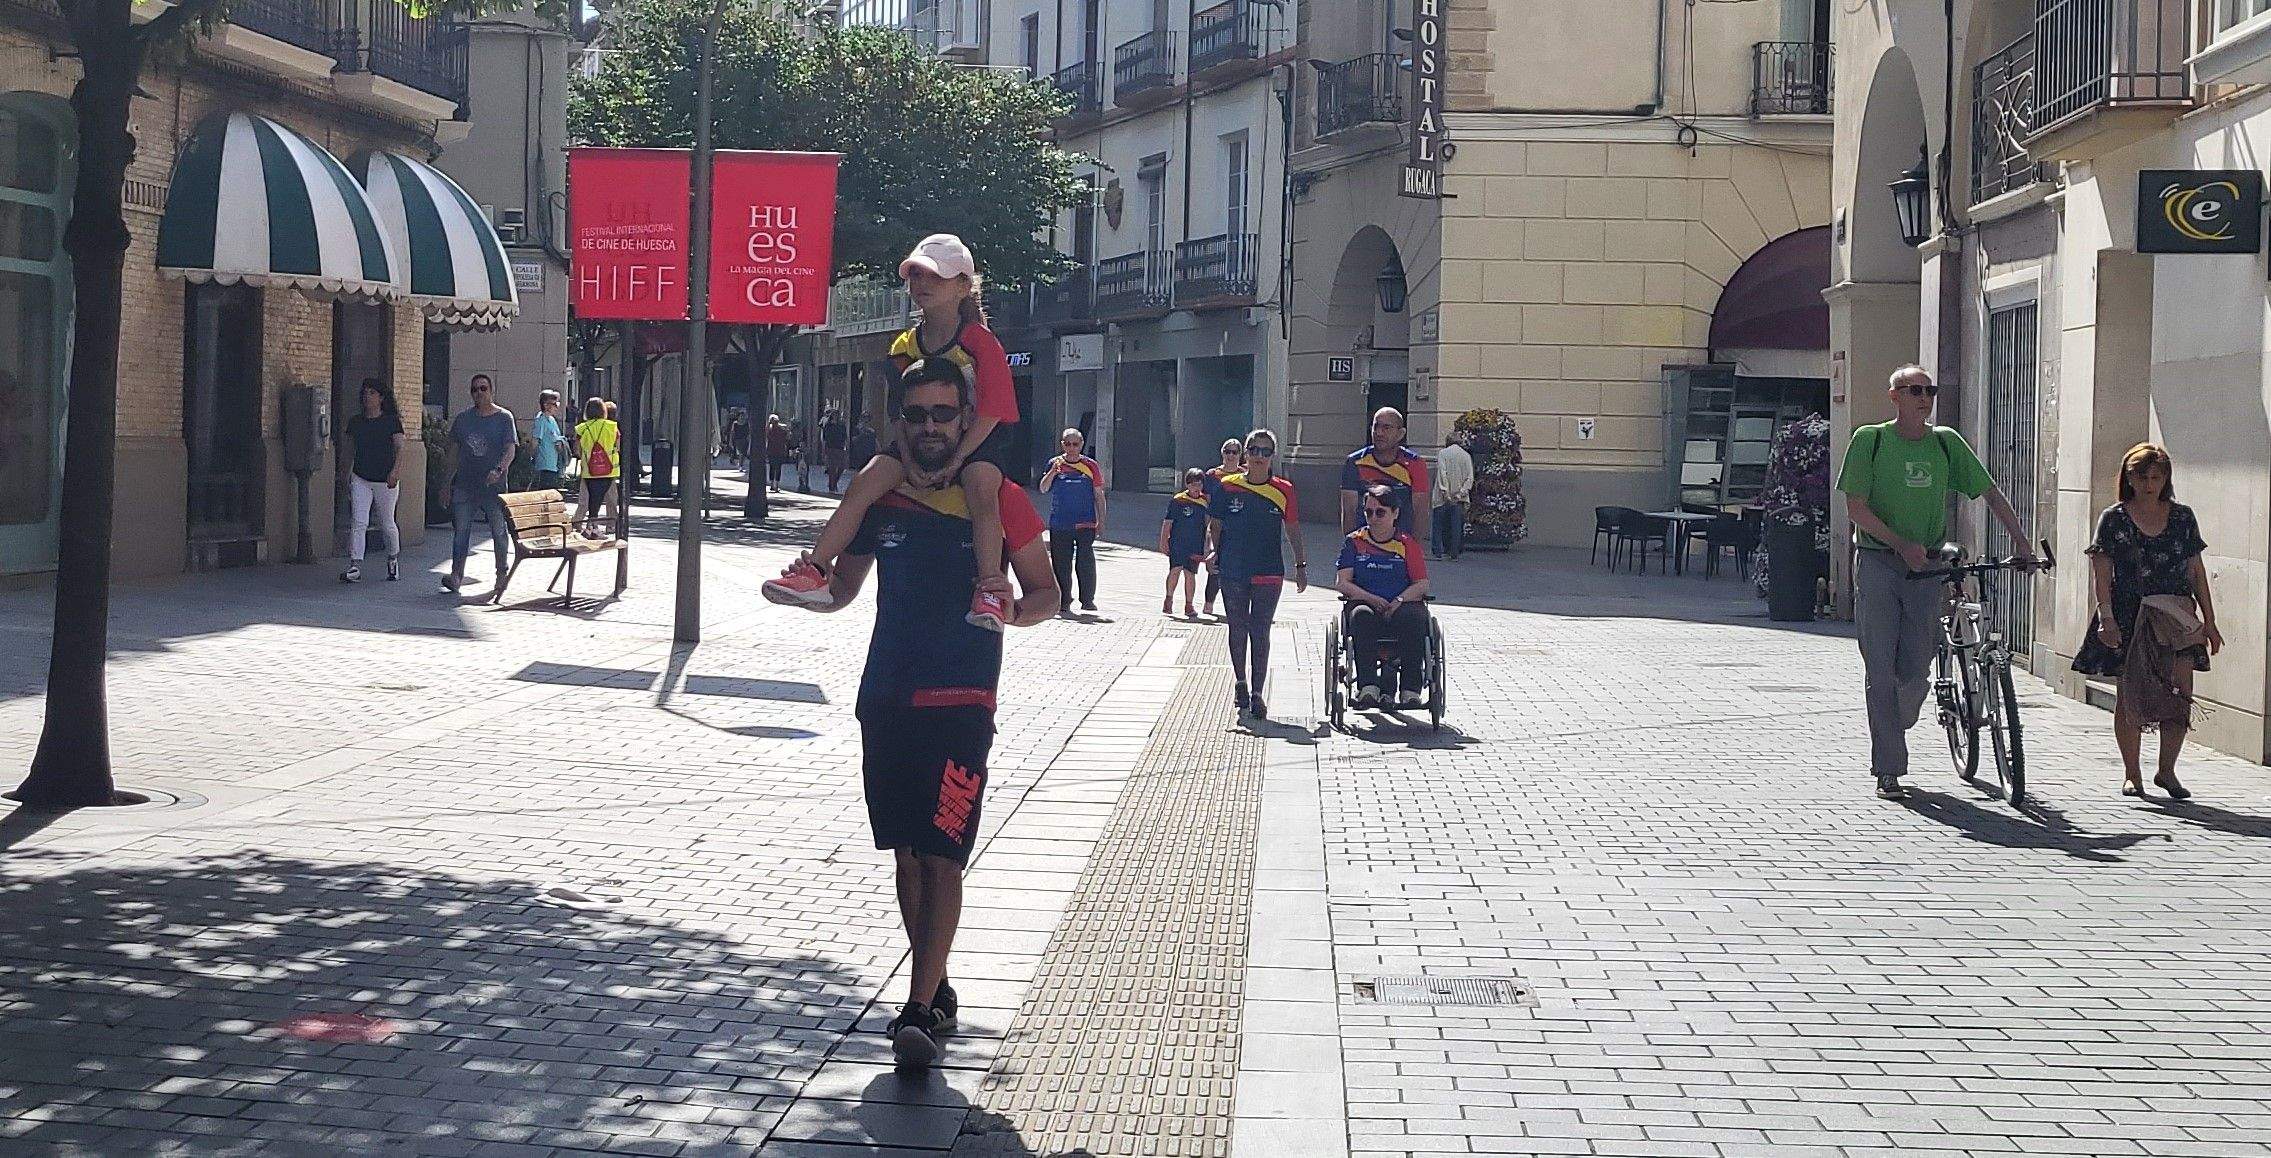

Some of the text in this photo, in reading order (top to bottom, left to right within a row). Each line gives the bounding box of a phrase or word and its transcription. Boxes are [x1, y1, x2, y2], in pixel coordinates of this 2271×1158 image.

[1418, 0, 1439, 161] HOSTAL
[1405, 166, 1436, 196] RUGACA
[581, 222, 675, 237] FESTIVAL INTERNACIONAL
[581, 238, 676, 251] DE CINE DE HUESCA
[580, 265, 676, 302] HIFF
[933, 758, 981, 845] NIKE
